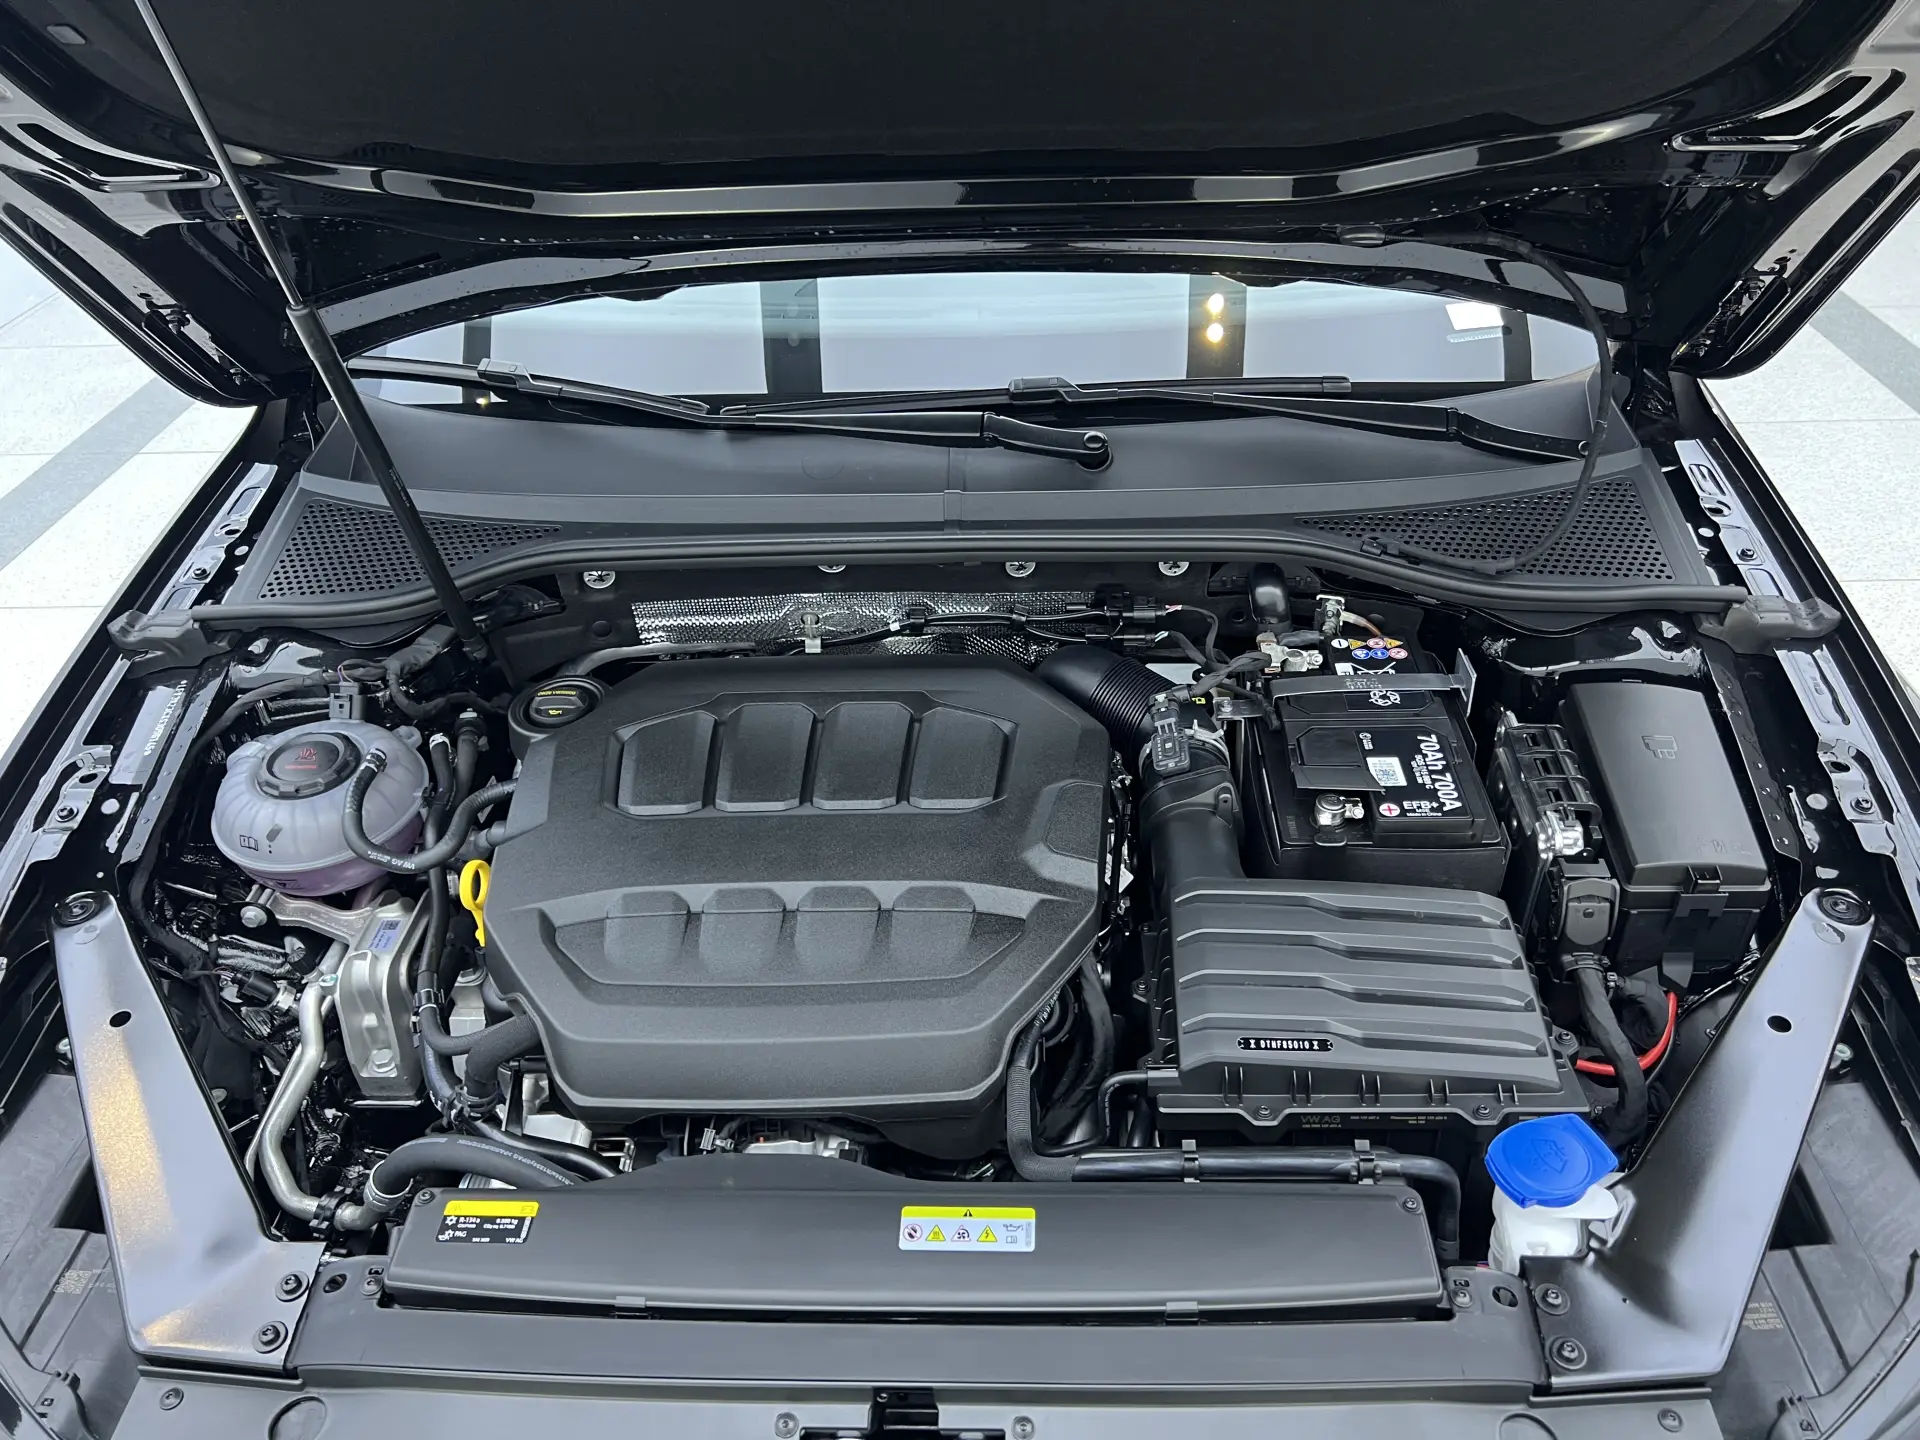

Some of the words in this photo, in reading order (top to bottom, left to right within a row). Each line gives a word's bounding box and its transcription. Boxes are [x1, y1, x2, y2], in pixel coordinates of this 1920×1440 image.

[1417, 734, 1447, 770] 70Ah
[1431, 772, 1462, 811] 700A
[1402, 800, 1440, 810] EFB+
[1300, 1115, 1320, 1124] VW
[1322, 1115, 1341, 1124] AG
